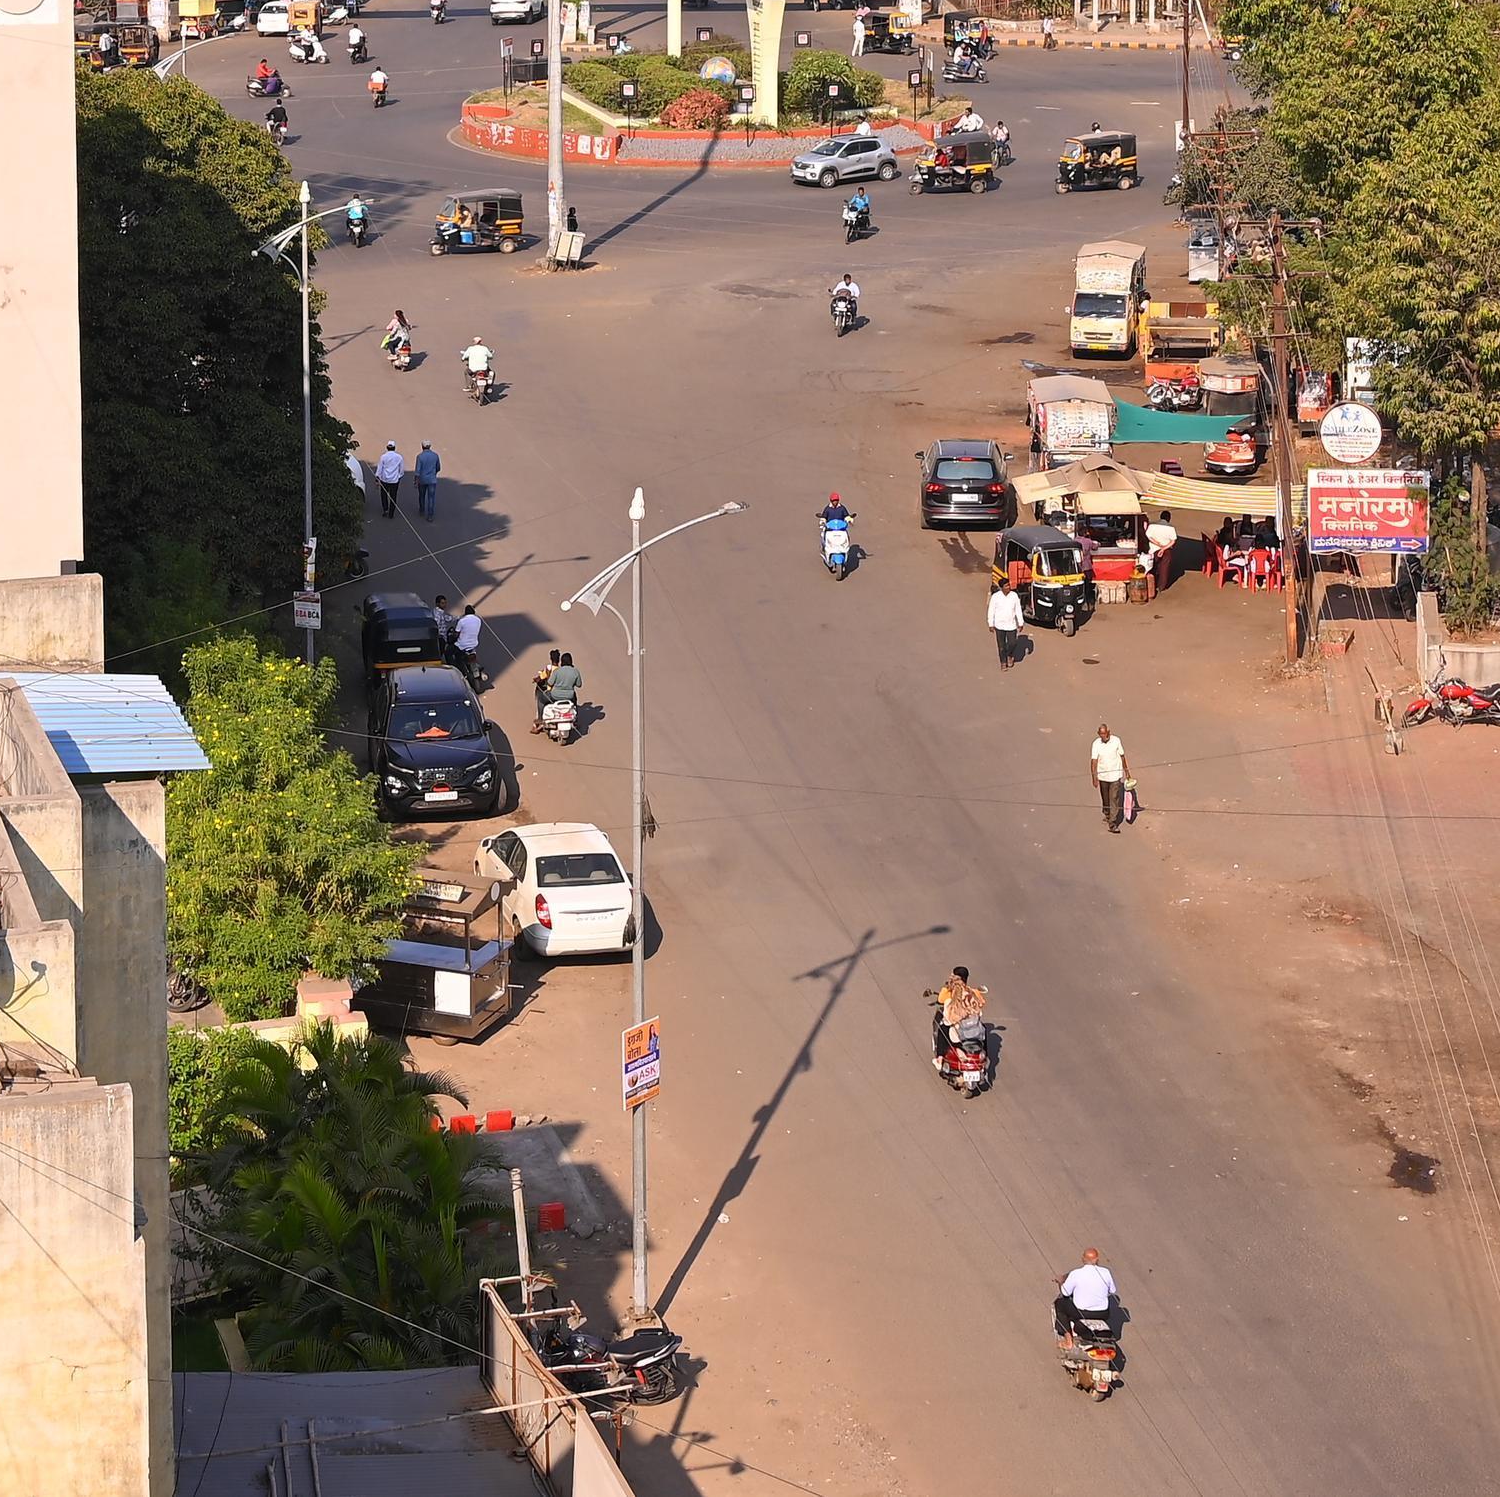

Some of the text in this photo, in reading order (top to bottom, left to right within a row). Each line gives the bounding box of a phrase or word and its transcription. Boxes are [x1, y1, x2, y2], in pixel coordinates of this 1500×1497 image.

[1318, 489, 1413, 528] मनोरमा
[1321, 516, 1379, 532] क्लिनिक
[307, 610, 320, 619] BCA
[639, 1064, 656, 1080] ASK
